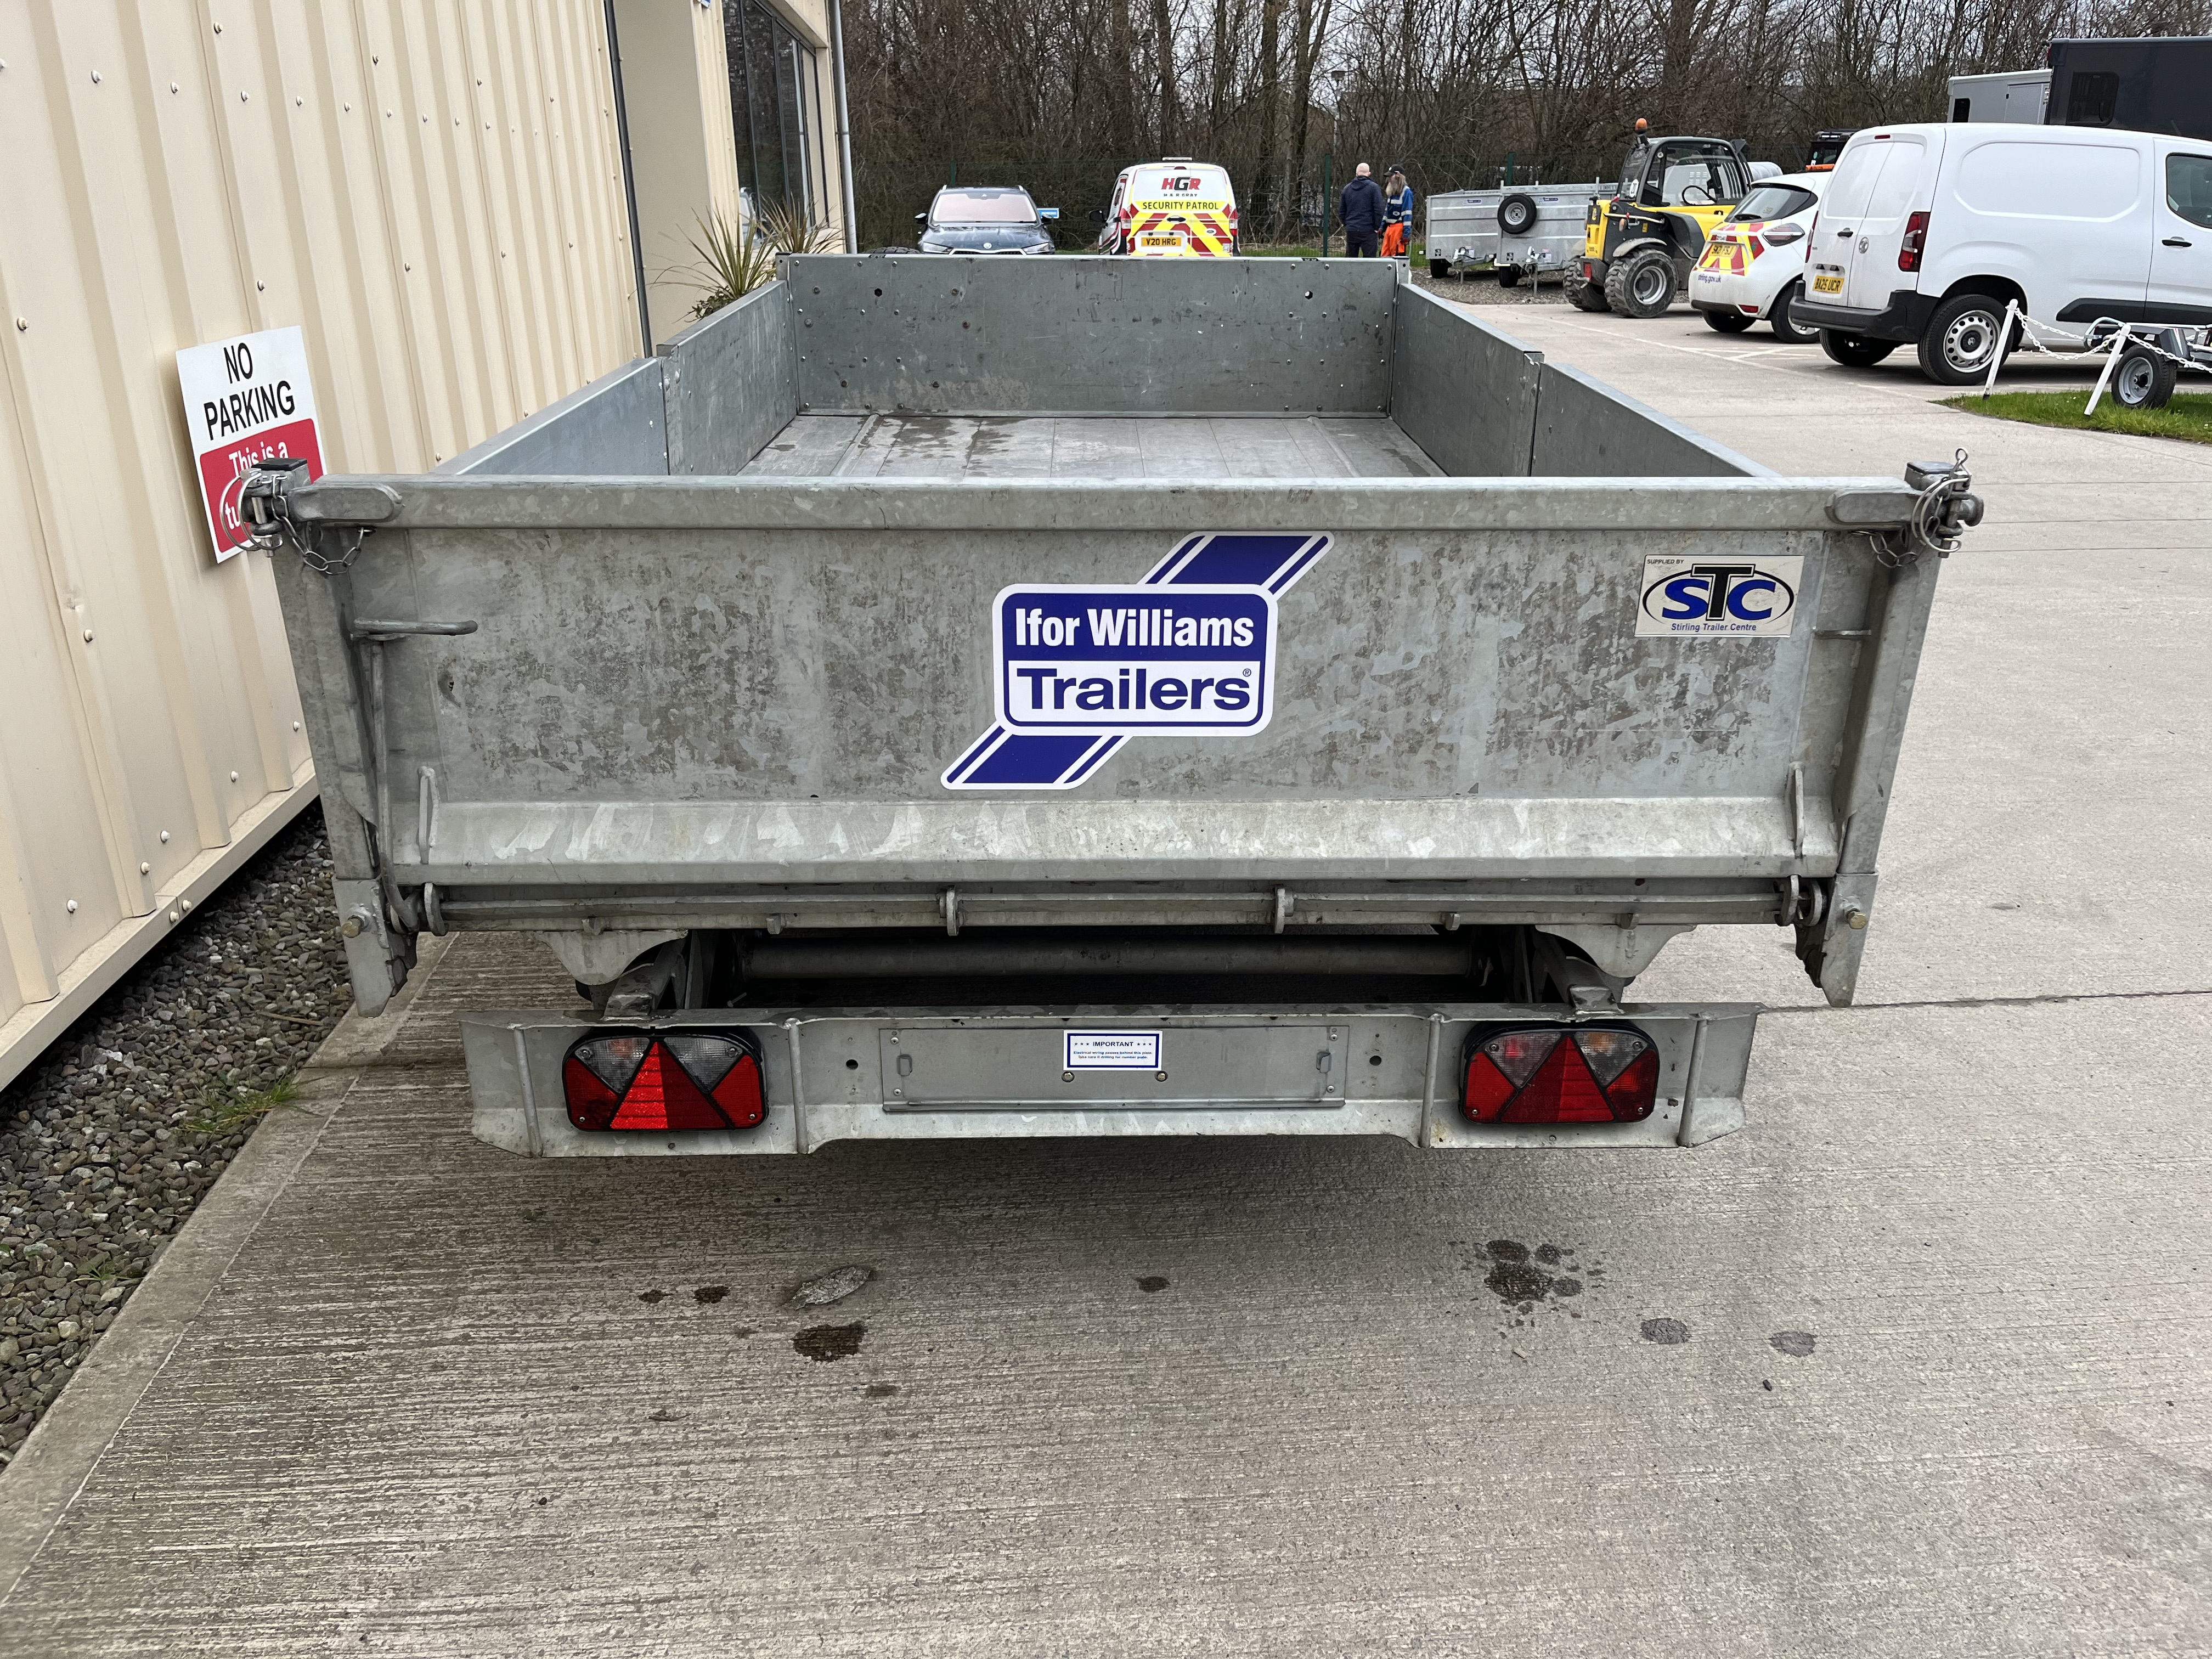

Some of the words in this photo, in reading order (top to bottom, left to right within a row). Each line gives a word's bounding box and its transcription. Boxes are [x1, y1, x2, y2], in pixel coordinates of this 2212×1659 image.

[1161, 176, 1201, 191] HGR
[1143, 201, 1183, 210] SECURITY
[223, 342, 253, 384] NO
[203, 380, 296, 441] PARKING
[228, 447, 259, 477] This
[260, 441, 275, 460] is
[278, 442, 289, 459] a
[1662, 563, 1776, 621] STC
[1015, 608, 1080, 646] Ifor
[1087, 608, 1254, 647] Williams
[1671, 623, 1700, 633] Stirling
[1017, 668, 1250, 710] Trailers
